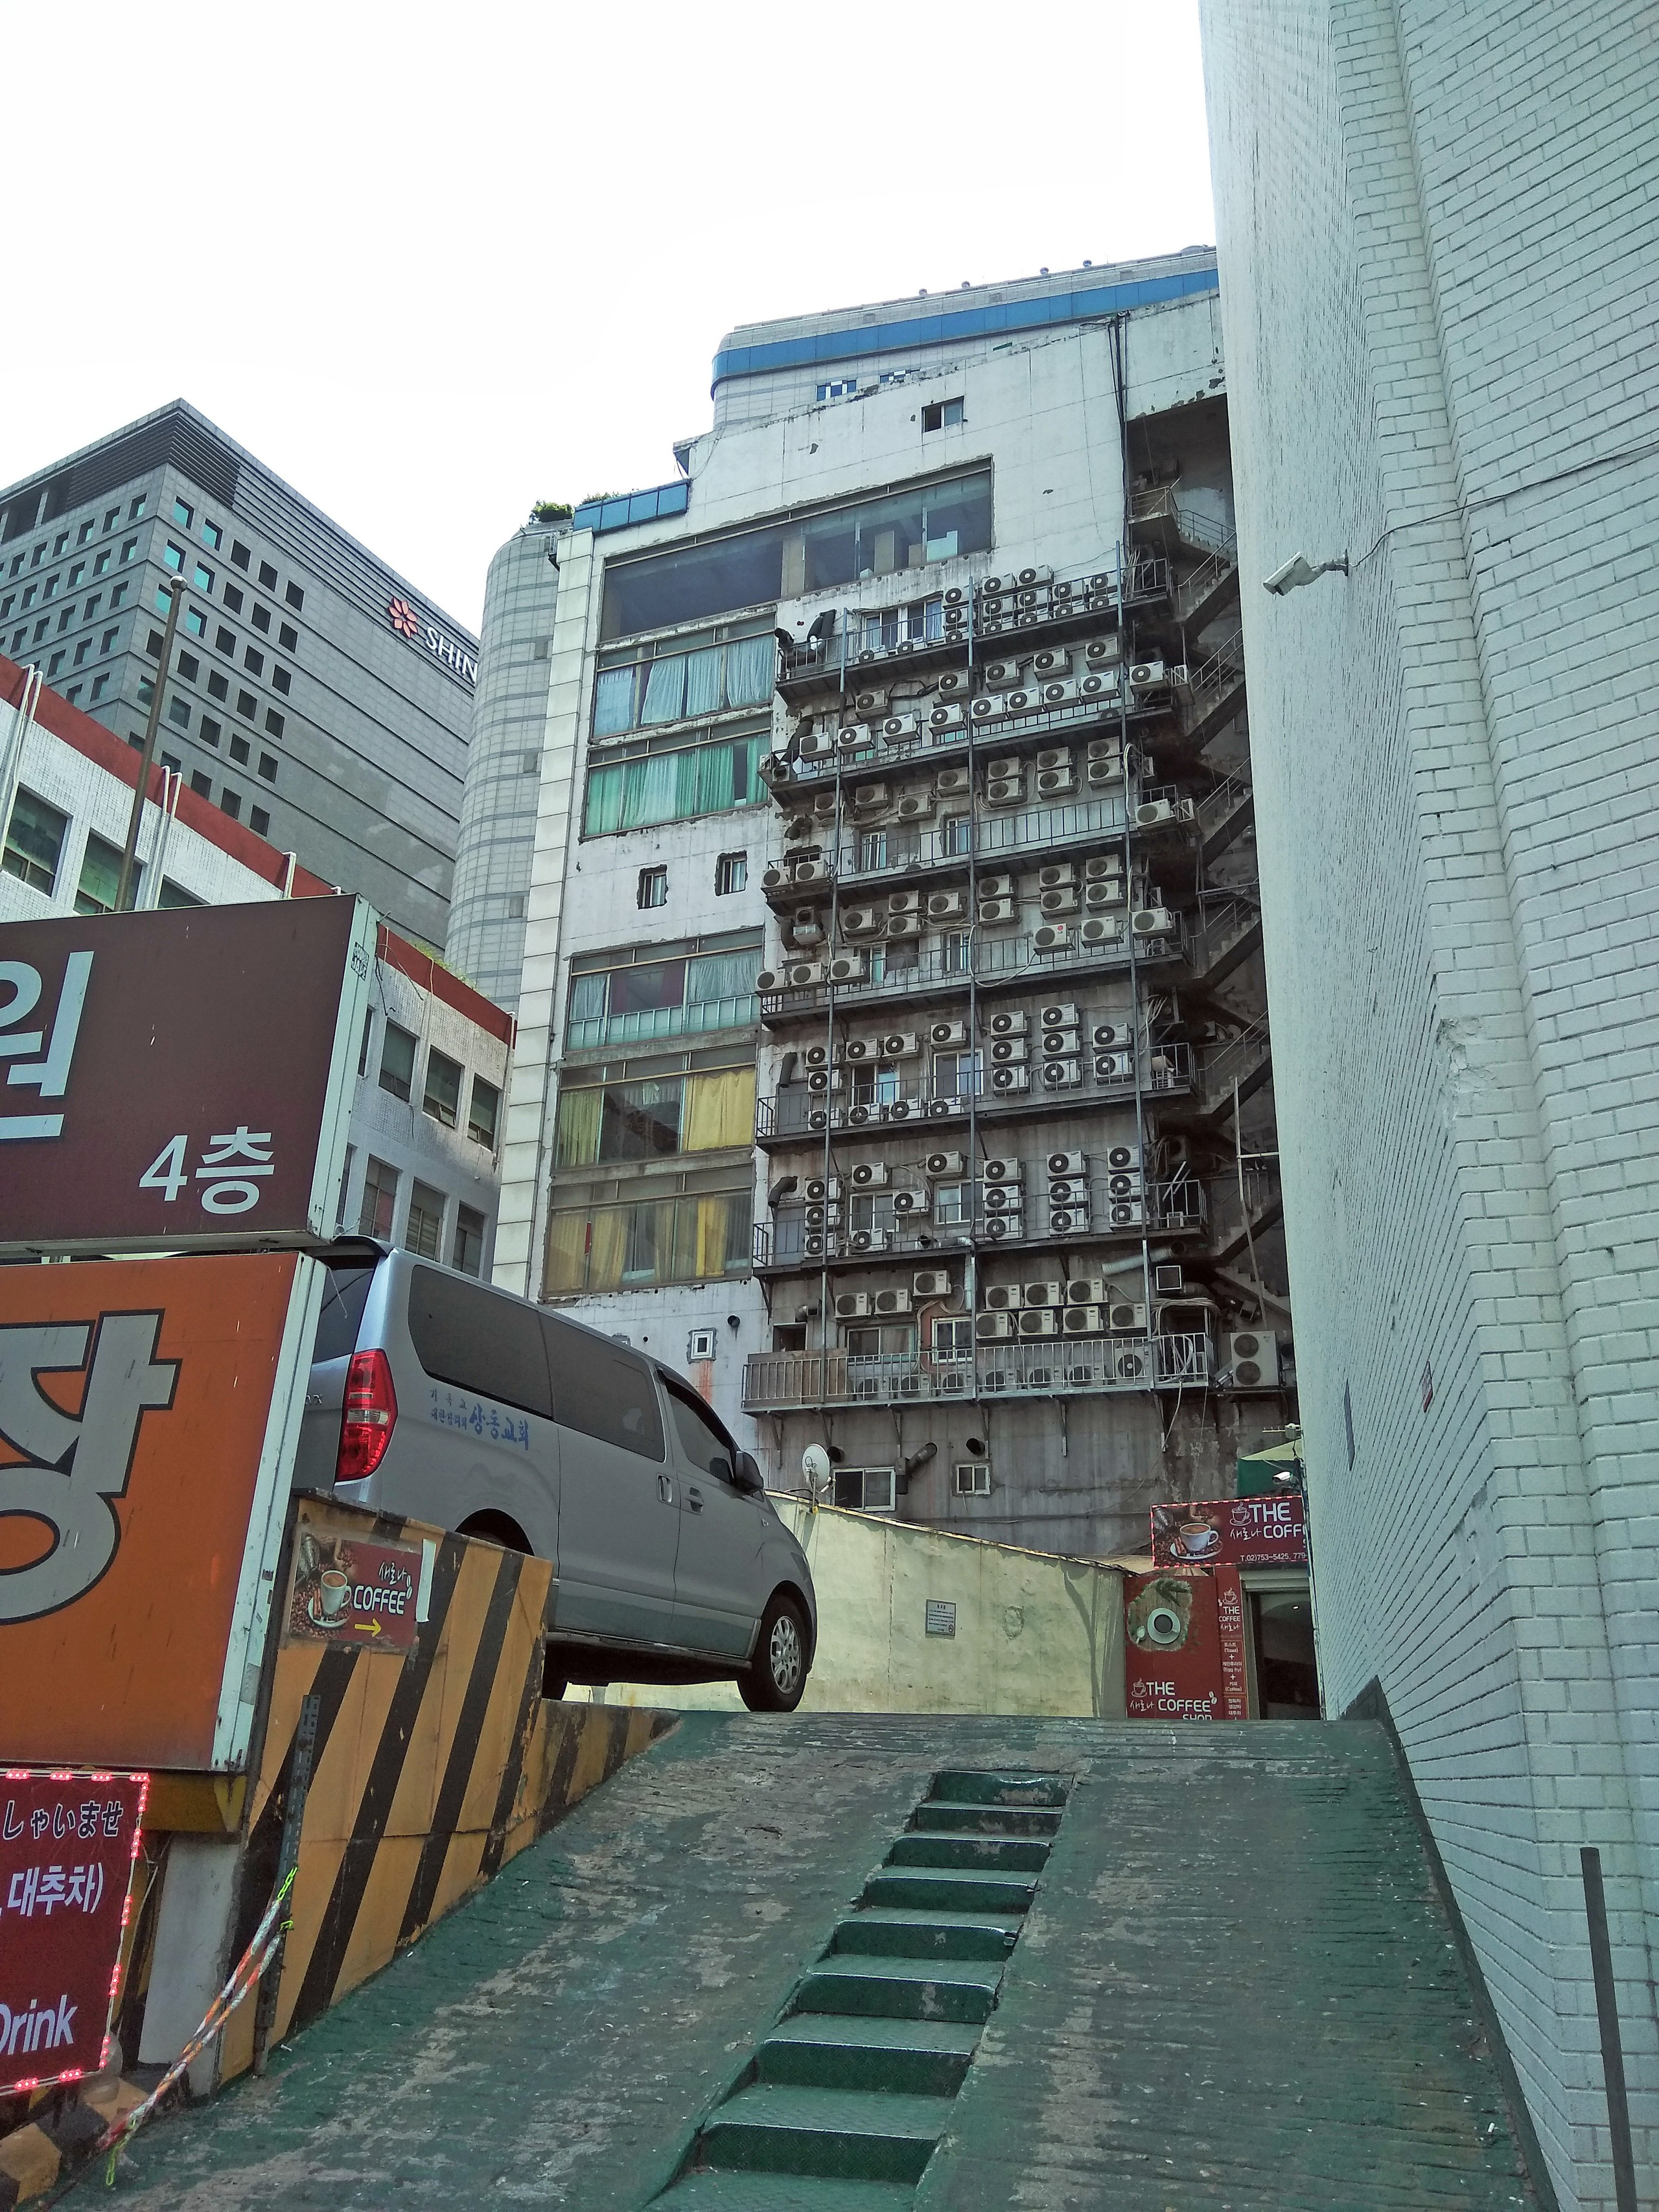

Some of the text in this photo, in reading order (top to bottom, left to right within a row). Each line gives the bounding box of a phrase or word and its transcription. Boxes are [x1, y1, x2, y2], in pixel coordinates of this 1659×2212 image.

[425, 626, 478, 684] SHIN
[139, 1126, 275, 1215] 4층
[1248, 1502, 1292, 1523] THE
[1230, 1527, 1262, 1541] 새로나
[378, 1561, 407, 1585] 새로나
[353, 1585, 406, 1614] COFFEE
[1223, 1606, 1240, 1614] THE
[1146, 1681, 1176, 1696] THE
[1130, 1699, 1211, 1712] 새로나 COFFEE
[3, 1800, 124, 1841] しゃいませ
